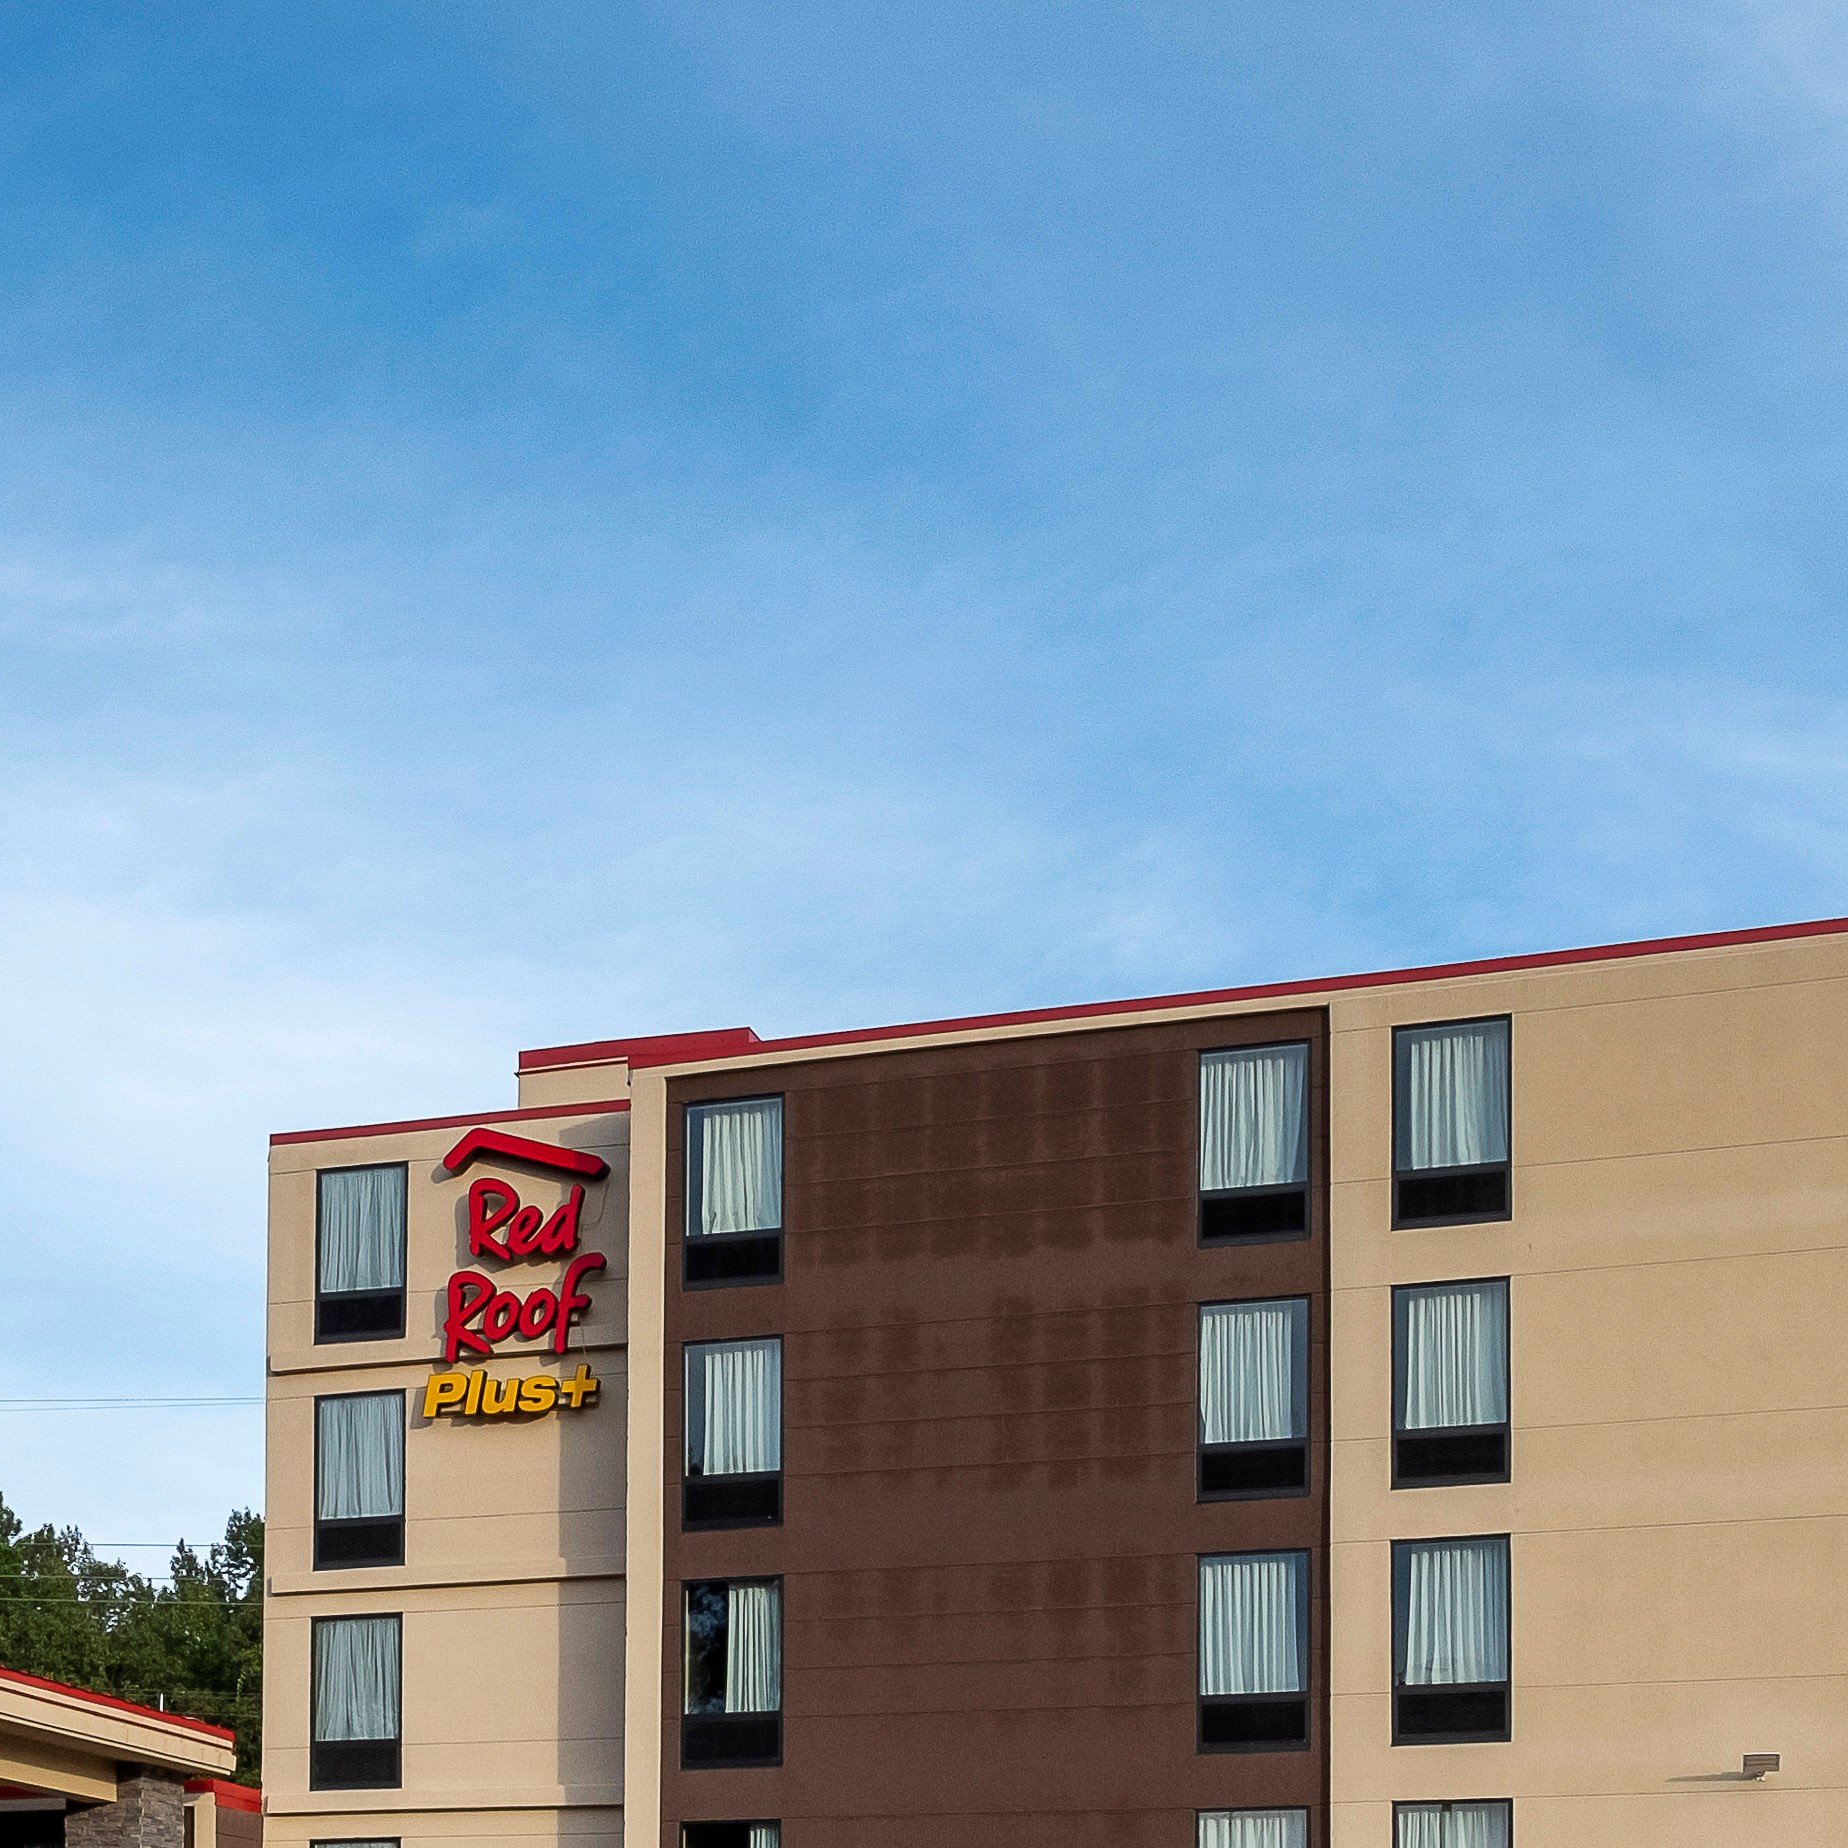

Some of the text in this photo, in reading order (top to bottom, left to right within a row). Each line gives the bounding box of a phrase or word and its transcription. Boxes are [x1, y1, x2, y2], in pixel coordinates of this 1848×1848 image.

[469, 1178, 585, 1260] Red
[443, 1252, 607, 1363] Roof
[423, 1364, 600, 1418] Plus+
